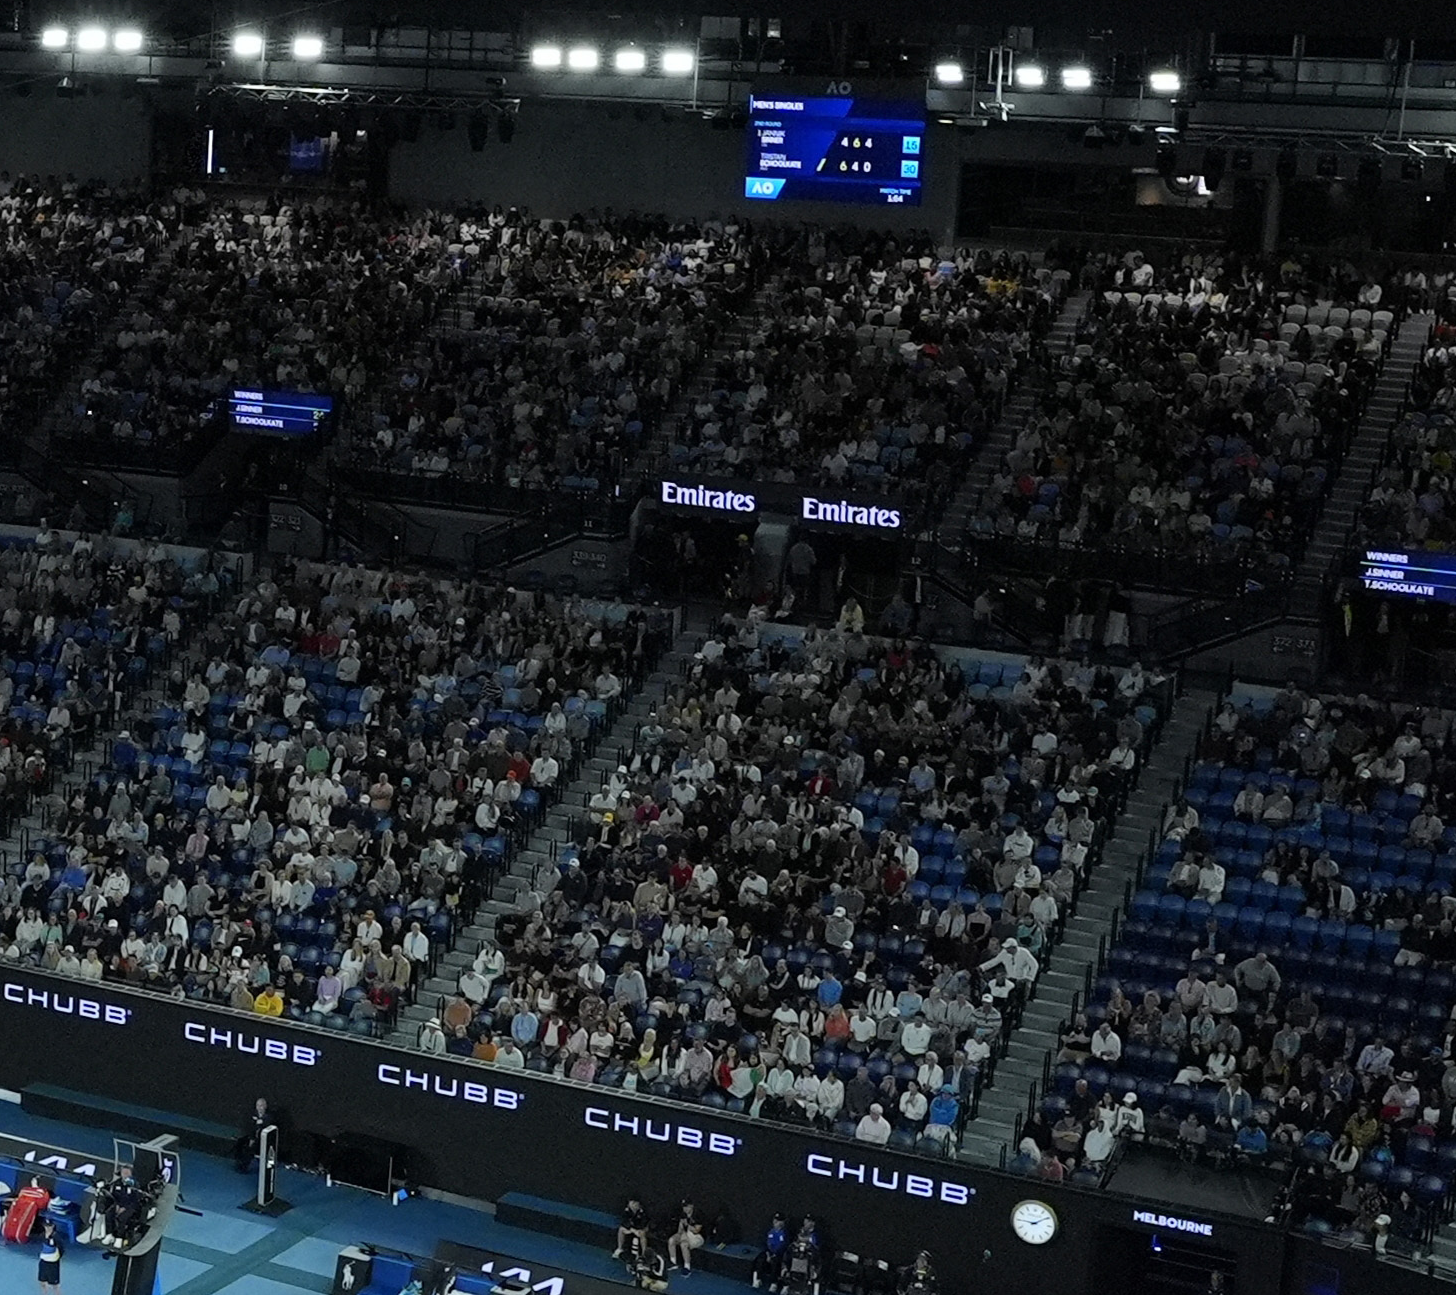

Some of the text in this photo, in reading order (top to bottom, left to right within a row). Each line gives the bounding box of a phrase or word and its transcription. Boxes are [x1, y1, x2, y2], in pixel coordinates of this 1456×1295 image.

[827, 81, 851, 94] AO
[841, 137, 848, 147] 4
[853, 137, 860, 148] 6
[865, 138, 872, 148] 4
[906, 140, 918, 151] 15
[840, 161, 847, 171] 6
[851, 161, 859, 171] 4
[863, 162, 871, 172] 0
[903, 164, 916, 174] 30
[752, 182, 774, 194] AO
[663, 482, 754, 511] Emirates
[803, 498, 899, 527] Emirates
[1366, 551, 1408, 564] WINNERS
[1365, 568, 1404, 580] J.SINNER
[1364, 579, 1434, 596] T.SCHOOLKATE
[4, 983, 127, 1025] CHUBB
[186, 1022, 316, 1066] CHUBB
[378, 1063, 519, 1110] CHUBB
[585, 1107, 736, 1155] CHUBB
[808, 1154, 968, 1205] CHUBB
[1134, 1210, 1212, 1236] MELBOURNE
